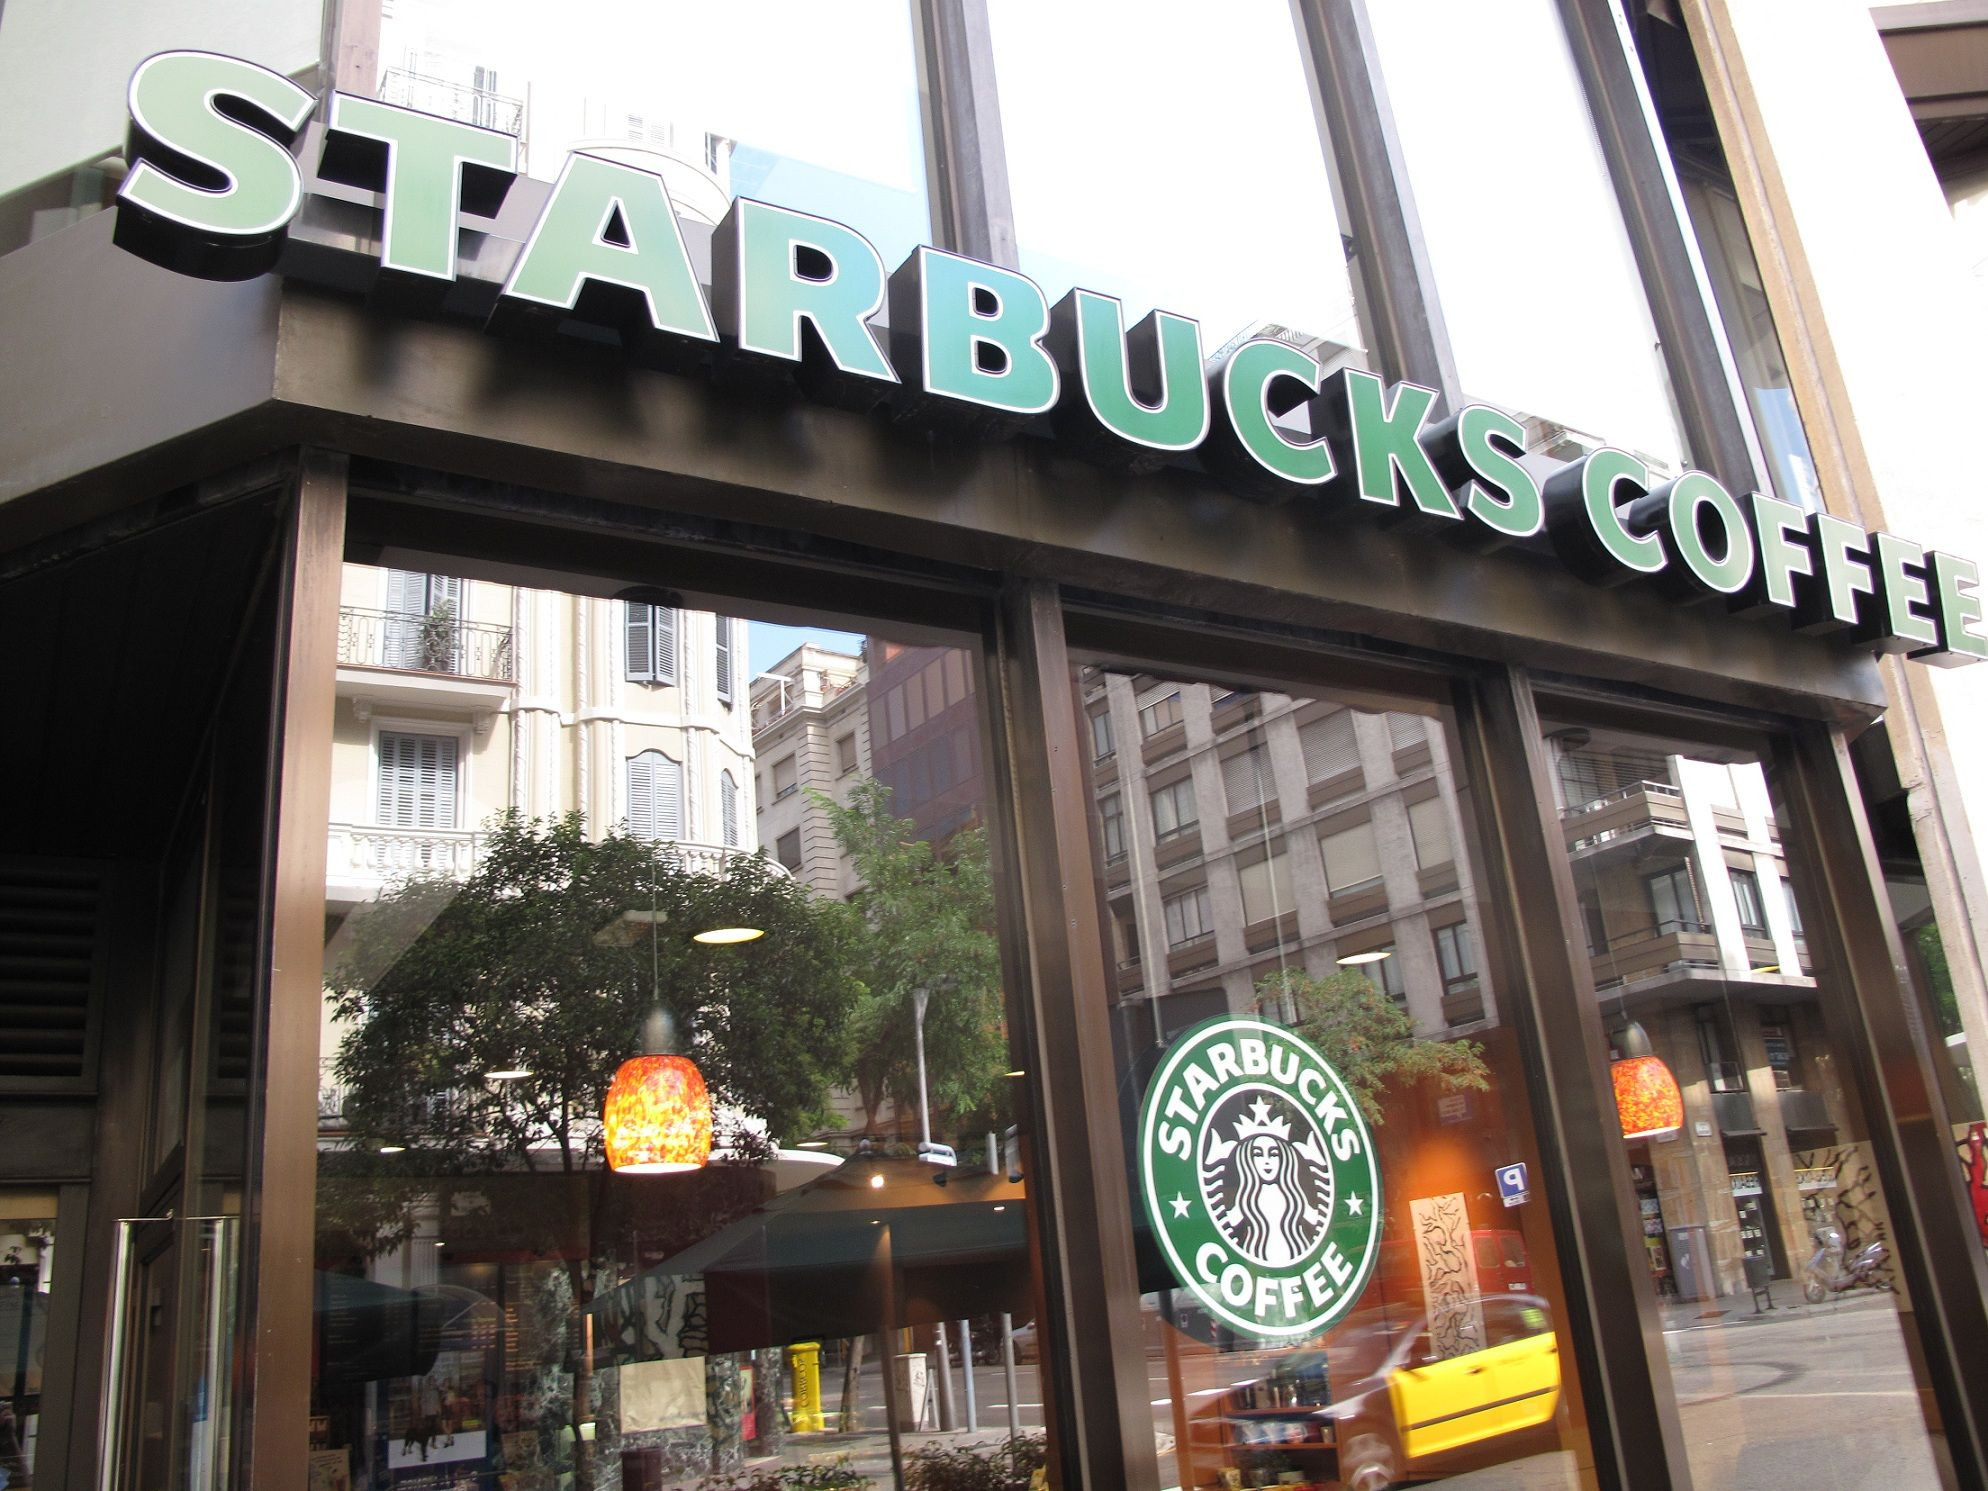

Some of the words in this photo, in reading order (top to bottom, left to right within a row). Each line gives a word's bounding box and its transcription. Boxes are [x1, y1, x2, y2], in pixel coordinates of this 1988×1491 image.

[118, 51, 1543, 537] STARBUCKS
[1582, 446, 1988, 658] COFFEE
[1158, 1038, 1361, 1162] STARBUCKS
[1194, 1241, 1354, 1319] COFFEE
